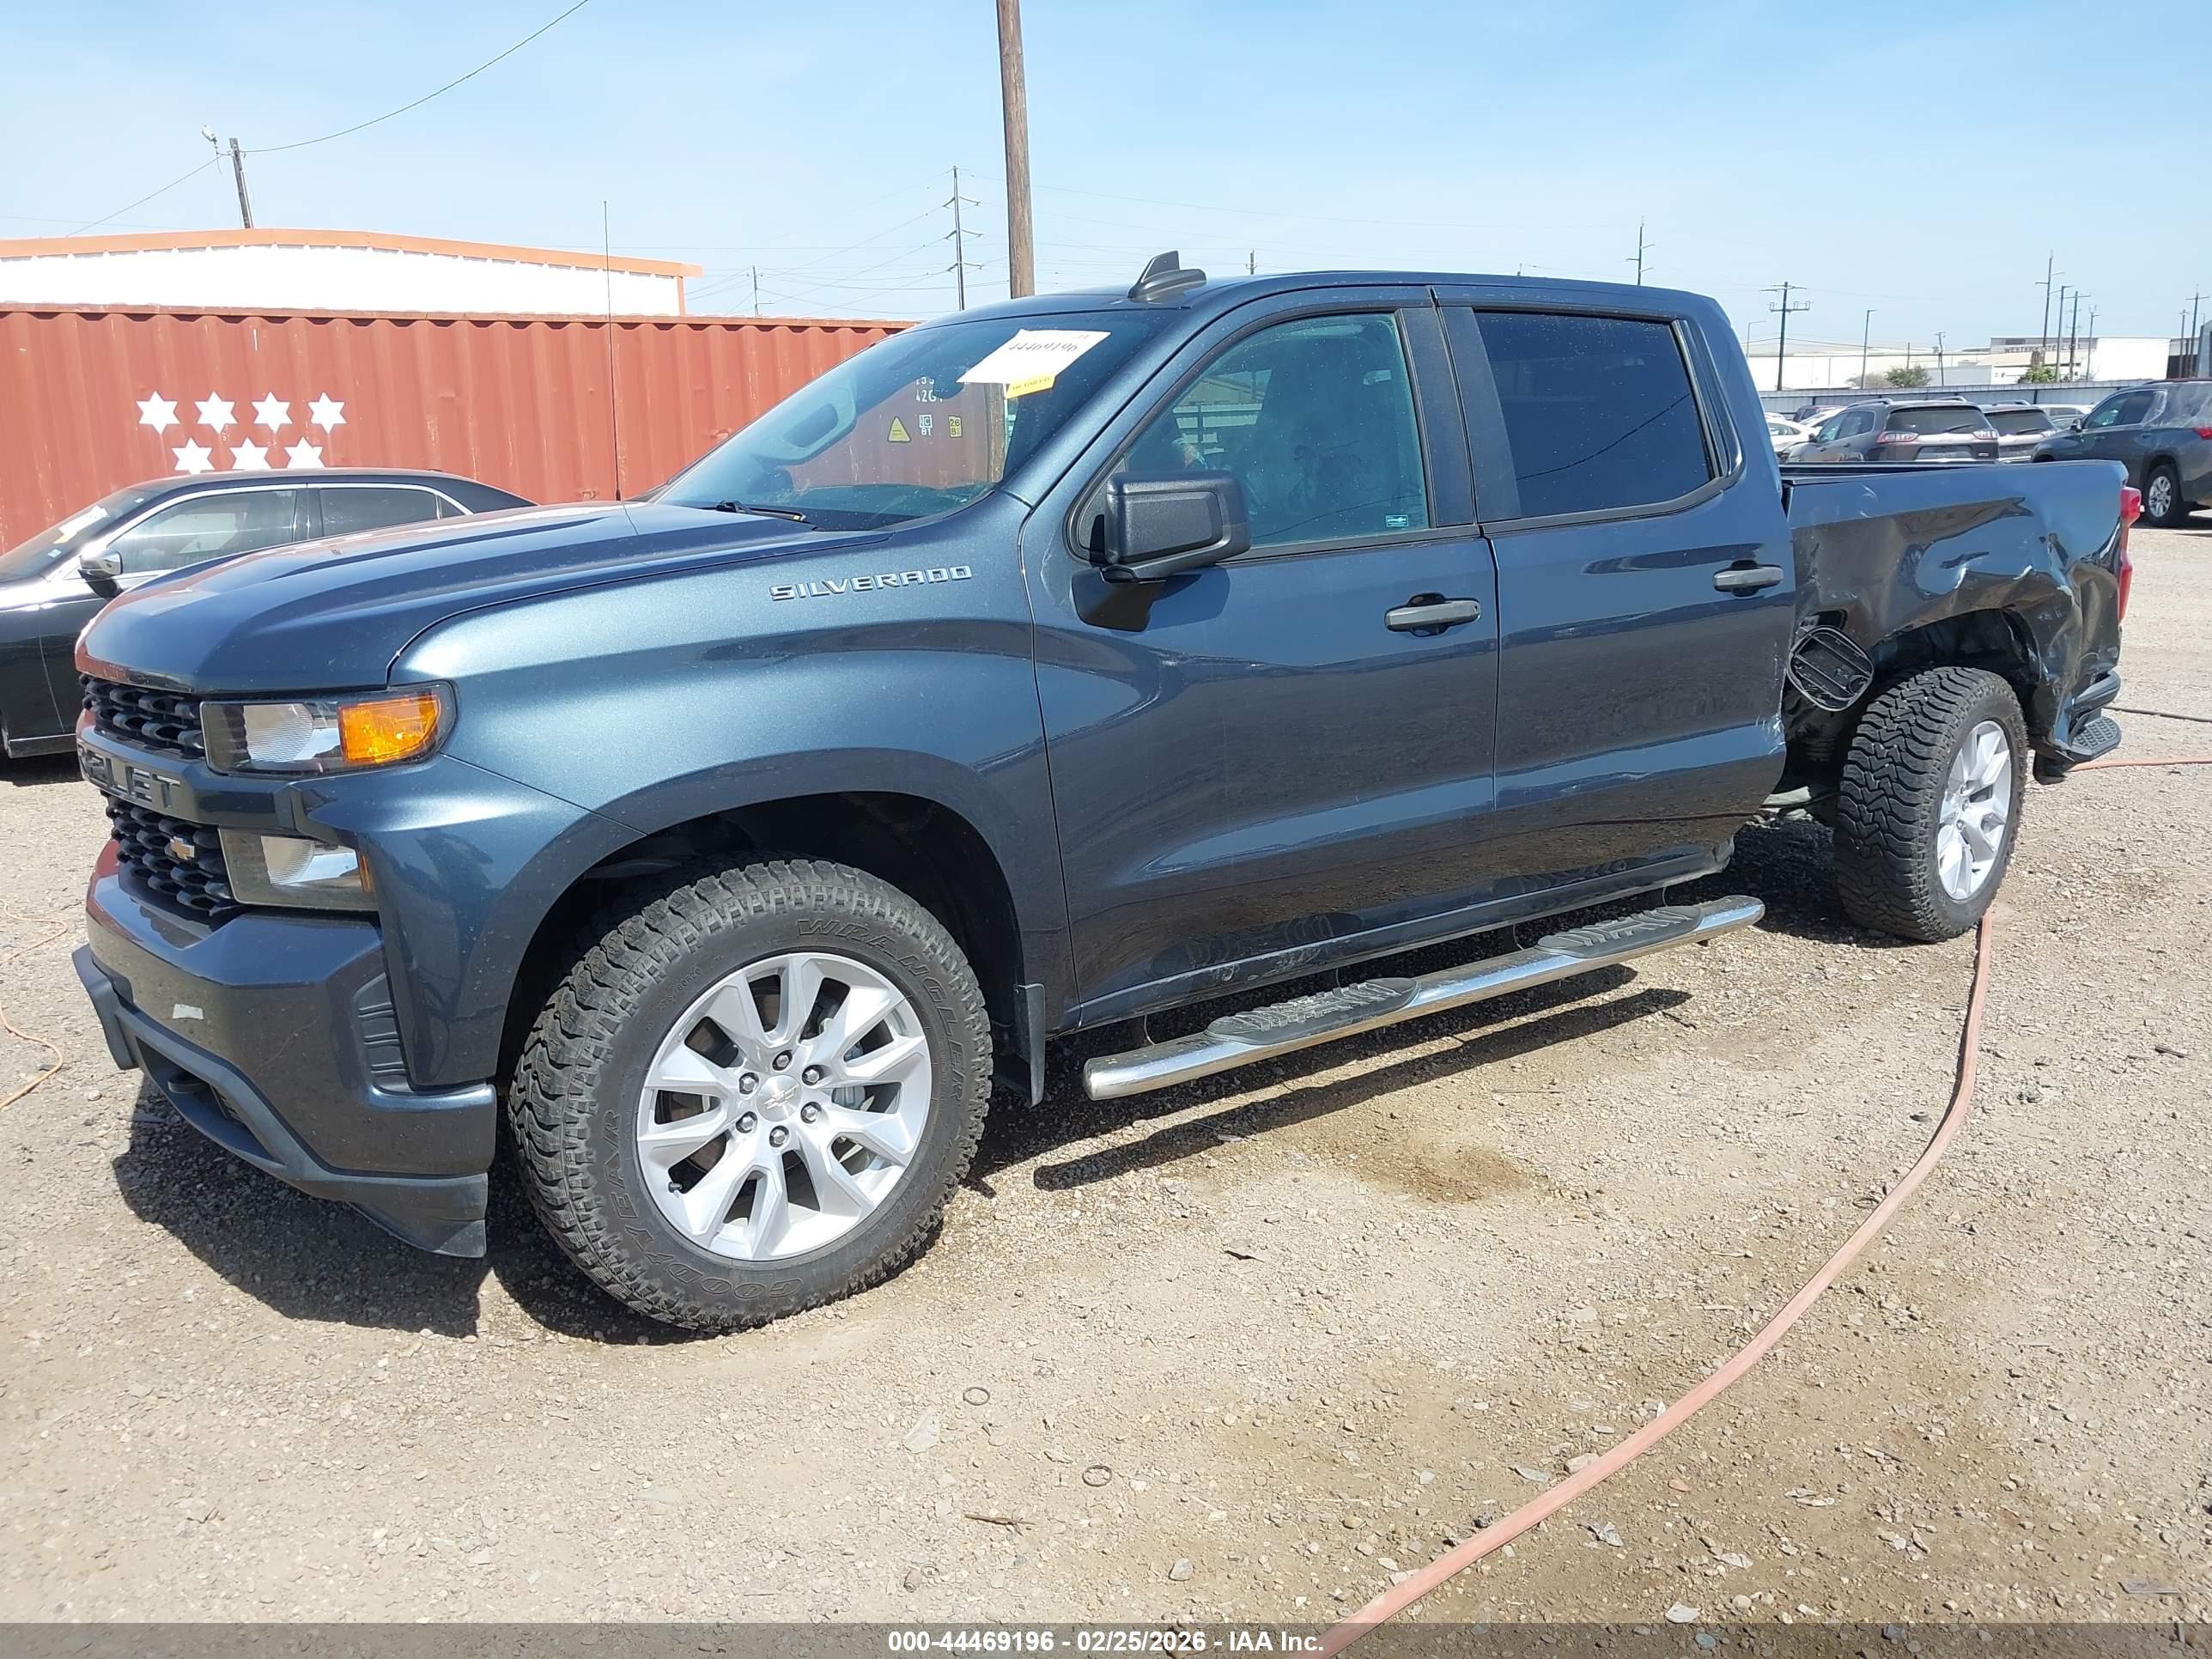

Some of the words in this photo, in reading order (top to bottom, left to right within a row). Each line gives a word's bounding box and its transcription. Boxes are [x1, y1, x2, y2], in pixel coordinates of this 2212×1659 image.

[769, 564, 973, 601] SILVERADO
[796, 919, 966, 1102] WRANGLER
[604, 1109, 805, 1299] GOODYEAR
